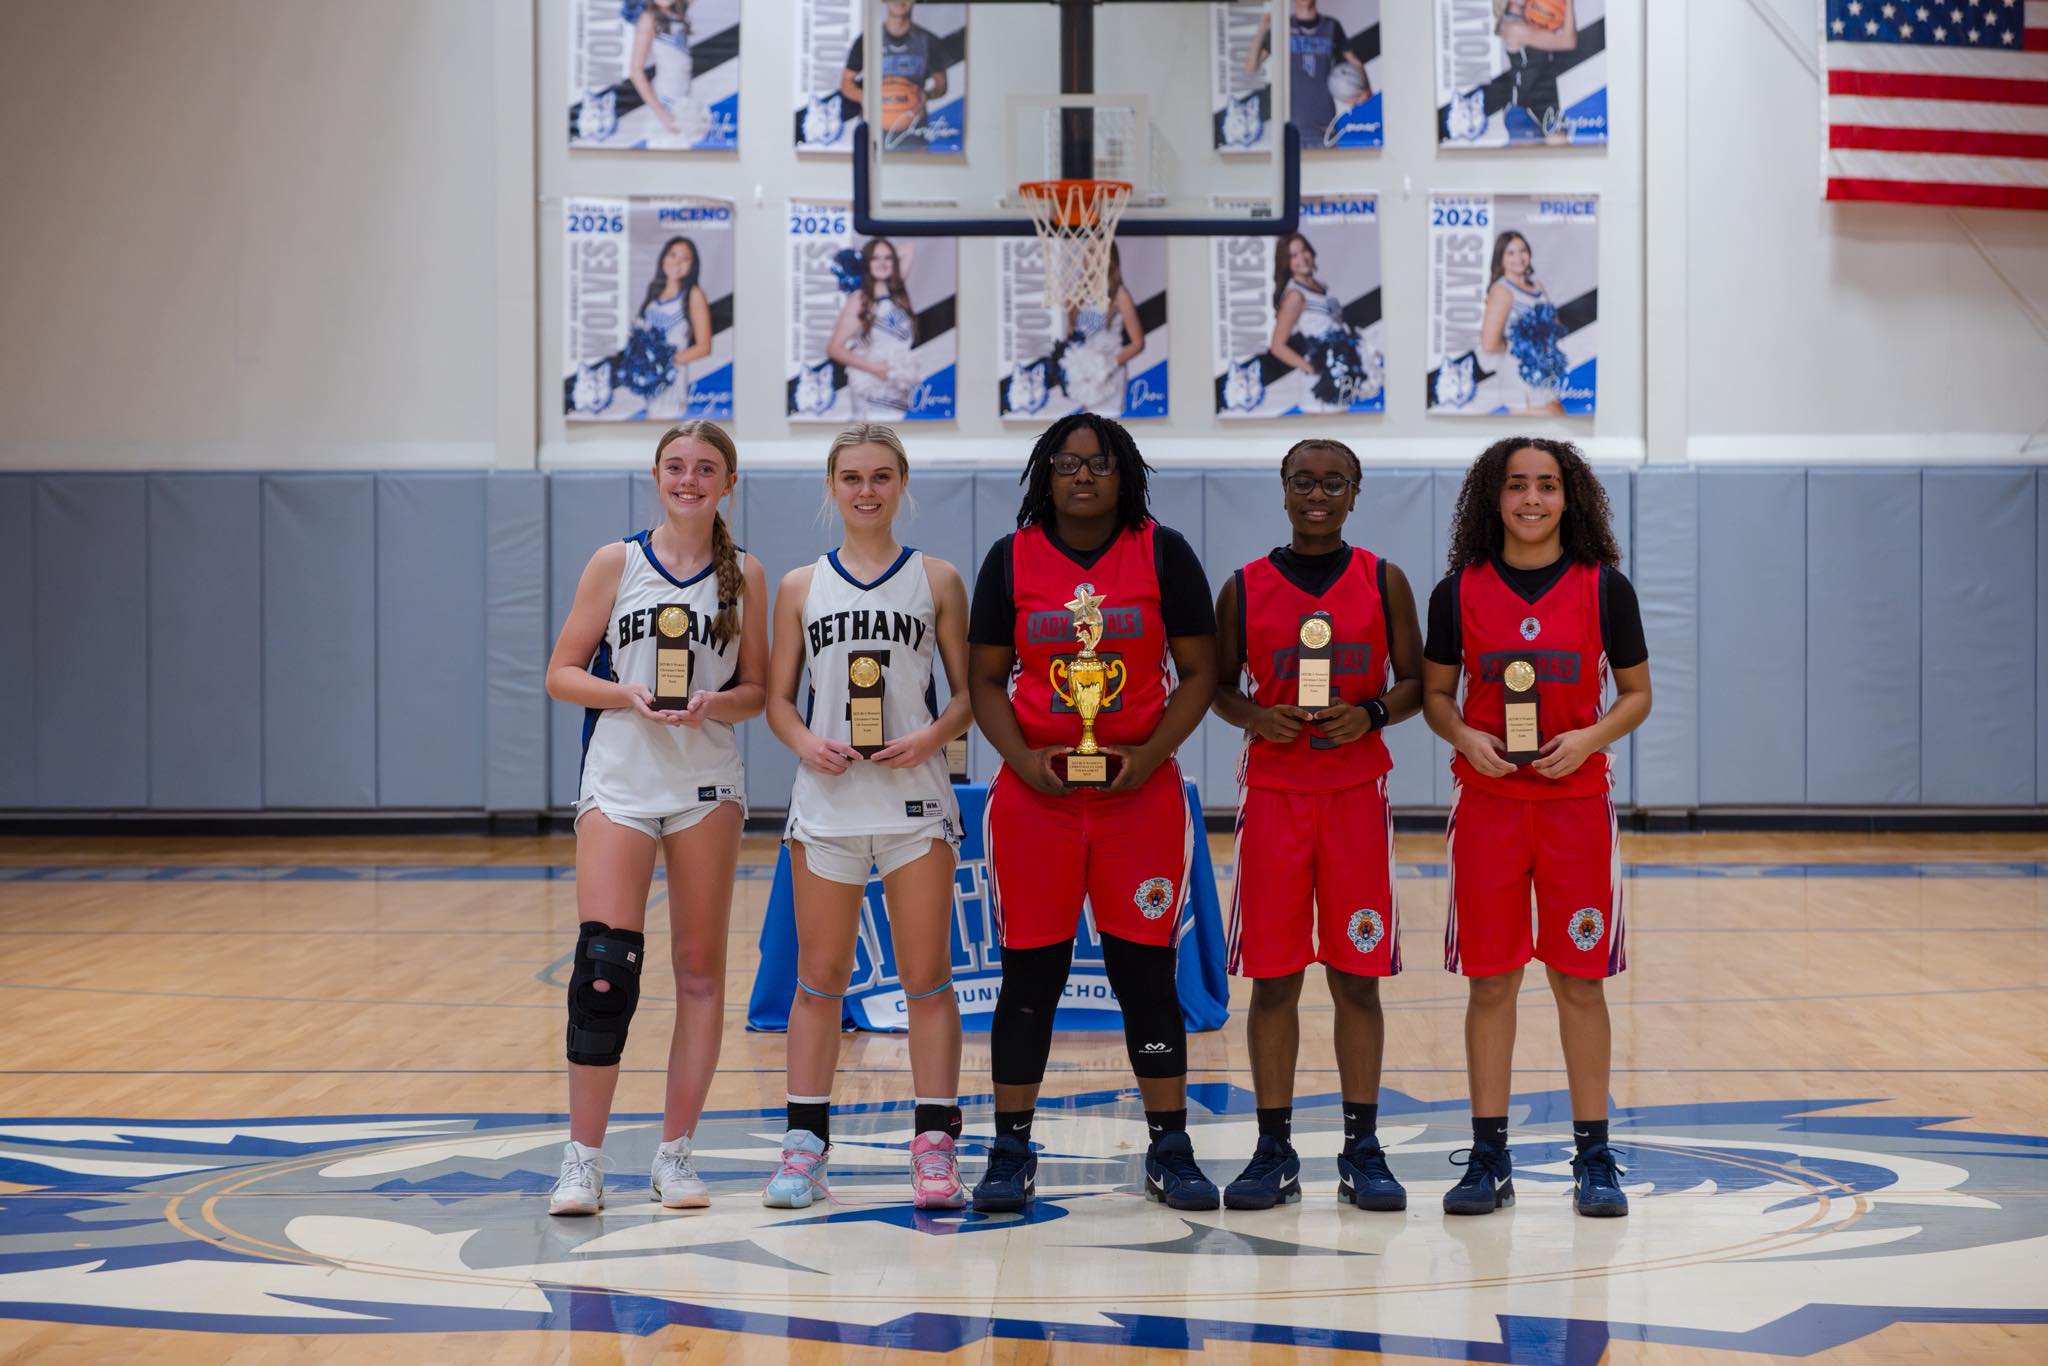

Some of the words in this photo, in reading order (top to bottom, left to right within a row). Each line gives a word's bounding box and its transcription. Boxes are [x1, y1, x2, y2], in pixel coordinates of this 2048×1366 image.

[658, 207, 730, 221] PICENO
[1299, 201, 1375, 216] OLEMAN
[1432, 208, 1489, 226] 2026
[1540, 201, 1595, 216] PRICE
[568, 215, 624, 233] 2026
[790, 217, 846, 234] 2026
[582, 240, 618, 359] WOLVES
[1229, 236, 1268, 357] WOLVES
[1446, 234, 1483, 352] WOLVES
[618, 608, 730, 657] BETAN
[807, 609, 927, 658] BETHANY
[1032, 615, 1069, 640] LADY
[1537, 655, 1574, 678] YALS
